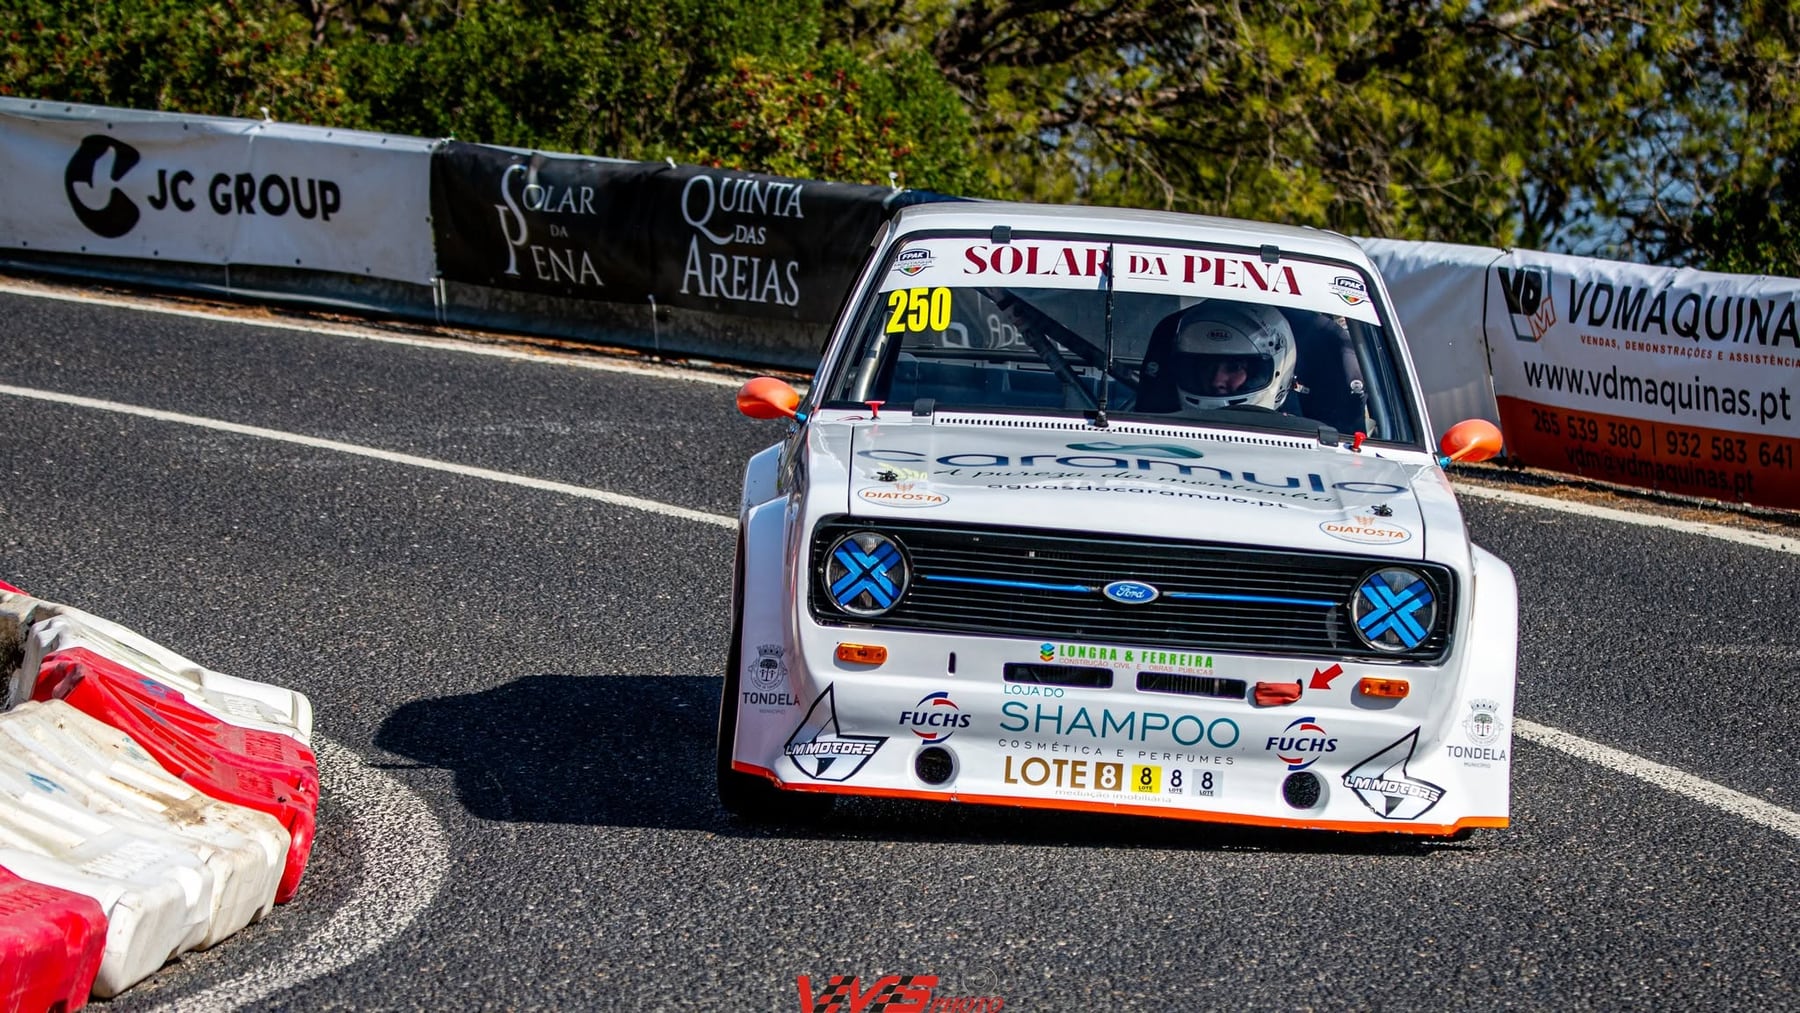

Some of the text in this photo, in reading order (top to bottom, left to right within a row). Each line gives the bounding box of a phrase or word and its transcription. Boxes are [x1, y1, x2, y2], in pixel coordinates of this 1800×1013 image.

[147, 169, 341, 222] JC GROUP
[500, 163, 597, 247] SOLAR
[681, 174, 804, 246] QUINTA
[551, 223, 568, 238] DA
[734, 225, 767, 245] DAS
[495, 204, 604, 287] PENA
[680, 235, 800, 306] AREIAS
[964, 245, 1302, 295] SOLAR DA PENA
[886, 287, 952, 333] 250
[1581, 335, 1621, 350] VENDAS,
[1625, 341, 1713, 360] DEMONSTRAÇÕES
[1718, 351, 1724, 360] E
[1524, 361, 1792, 424] www.vdmaquinas.pt
[1531, 408, 1561, 436] 265
[1567, 416, 1598, 443] 539
[1608, 422, 1642, 449] 380
[1666, 431, 1701, 458] 932
[1711, 437, 1747, 464] 583
[1758, 442, 1793, 469] 641
[857, 449, 1408, 494] caramulo
[864, 490, 943, 503] DIATOSTA
[988, 483, 1288, 508] aguasdocaramulo.pt
[1327, 523, 1405, 539] DIATOSTA
[1059, 644, 1213, 668] LONGRA & FERREIRA
[743, 692, 800, 706] TONDELA
[1004, 684, 1064, 697] LOJA DO
[899, 711, 971, 729] FUCHS
[1000, 701, 1240, 748] SHAMPOO
[805, 742, 877, 755] MOTORS
[998, 738, 1234, 765] COSMÉTICA E PERFUMES
[1265, 737, 1338, 753] FUCHS
[1446, 745, 1506, 761] TONDELA
[1004, 755, 1117, 789] LOTE 8
[1140, 767, 1152, 785] 8
[1171, 769, 1182, 787] 8
[1201, 771, 1213, 790] 8
[1371, 779, 1440, 802] MOTORS
